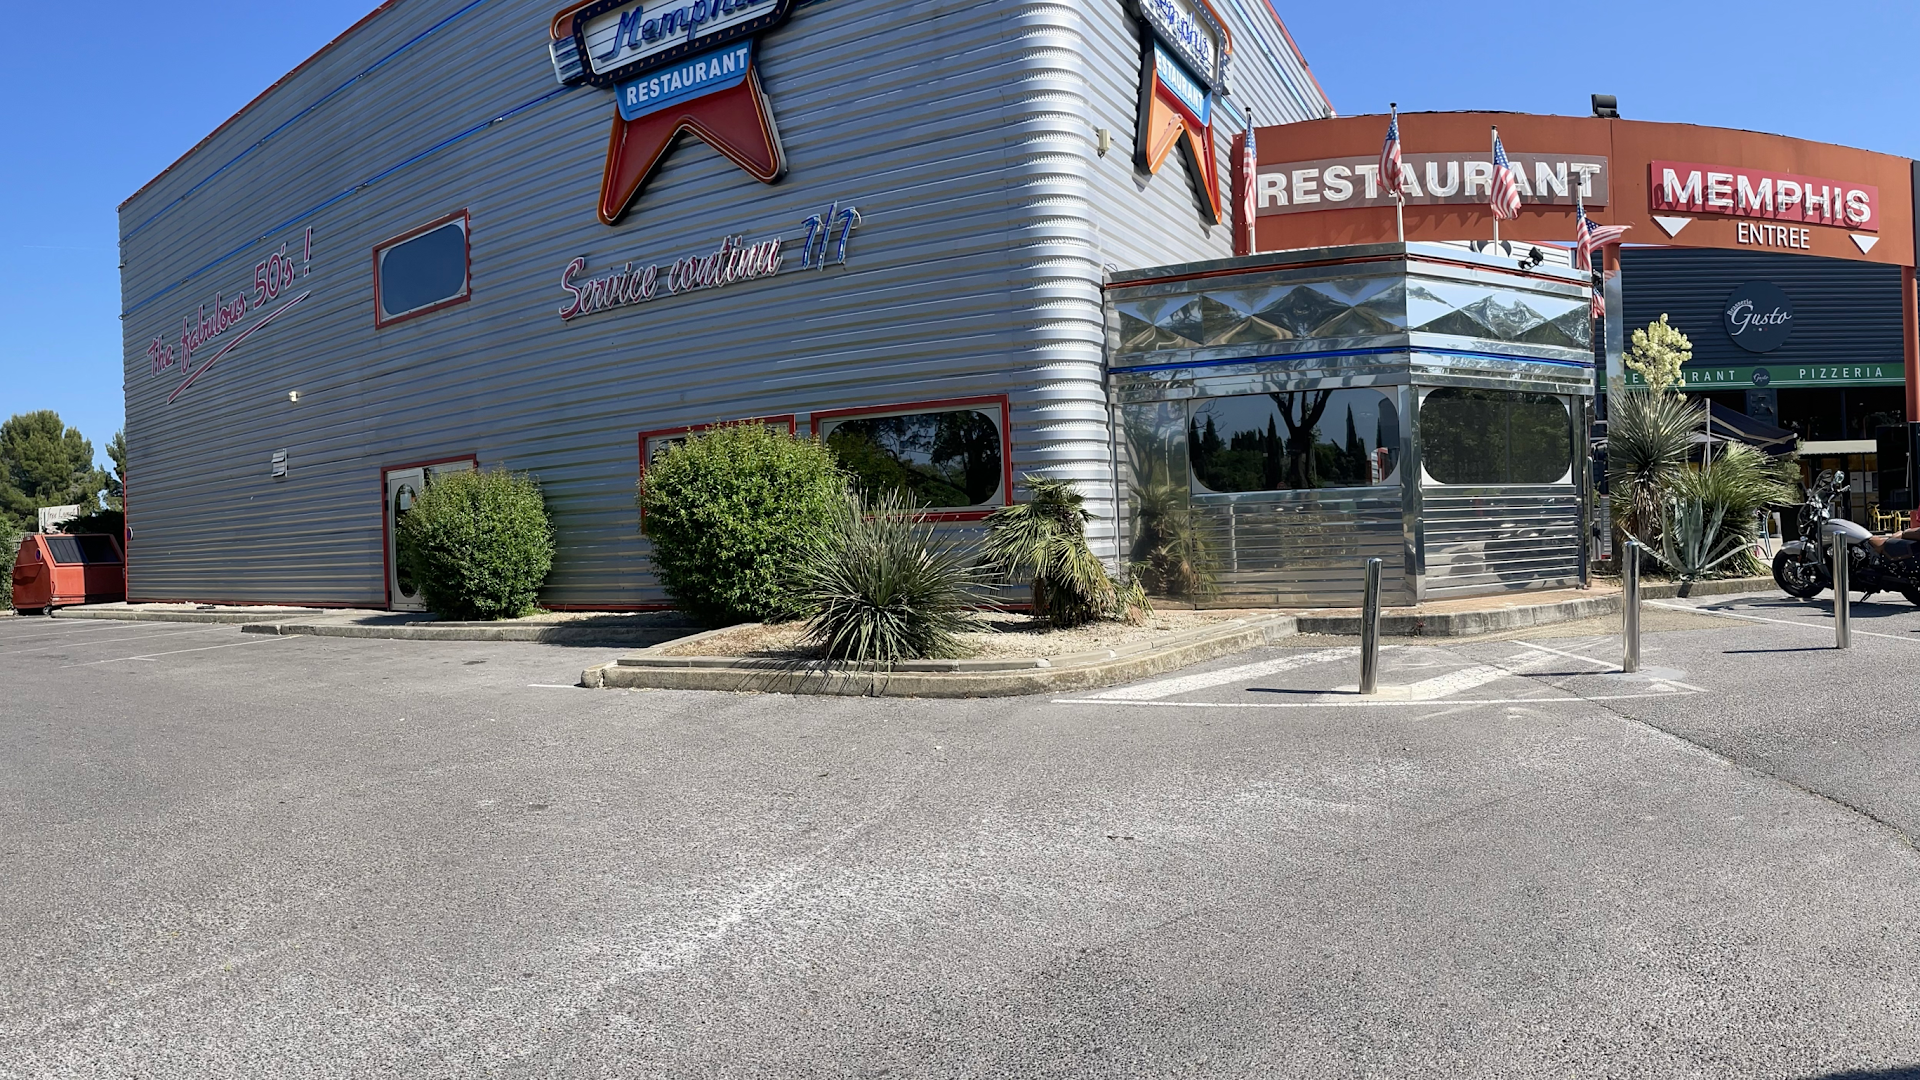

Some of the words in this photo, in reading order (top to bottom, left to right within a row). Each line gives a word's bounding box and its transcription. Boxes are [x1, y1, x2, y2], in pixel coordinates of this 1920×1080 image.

[626, 48, 748, 107] RESTAURANT
[1155, 47, 1204, 112] ESTAURANT
[1257, 159, 1602, 208] RESTAURANT
[1663, 168, 1871, 223] MEMPHIS
[558, 256, 658, 321] Service
[668, 235, 783, 295] continu
[801, 200, 861, 271] 7/7
[1738, 223, 1810, 248] ENTREE
[147, 334, 173, 377] The
[180, 290, 246, 375] fabulous
[1727, 299, 1752, 316] Brasserie
[1730, 307, 1792, 336] Gusto
[1799, 366, 1884, 379] PIZZERIA
